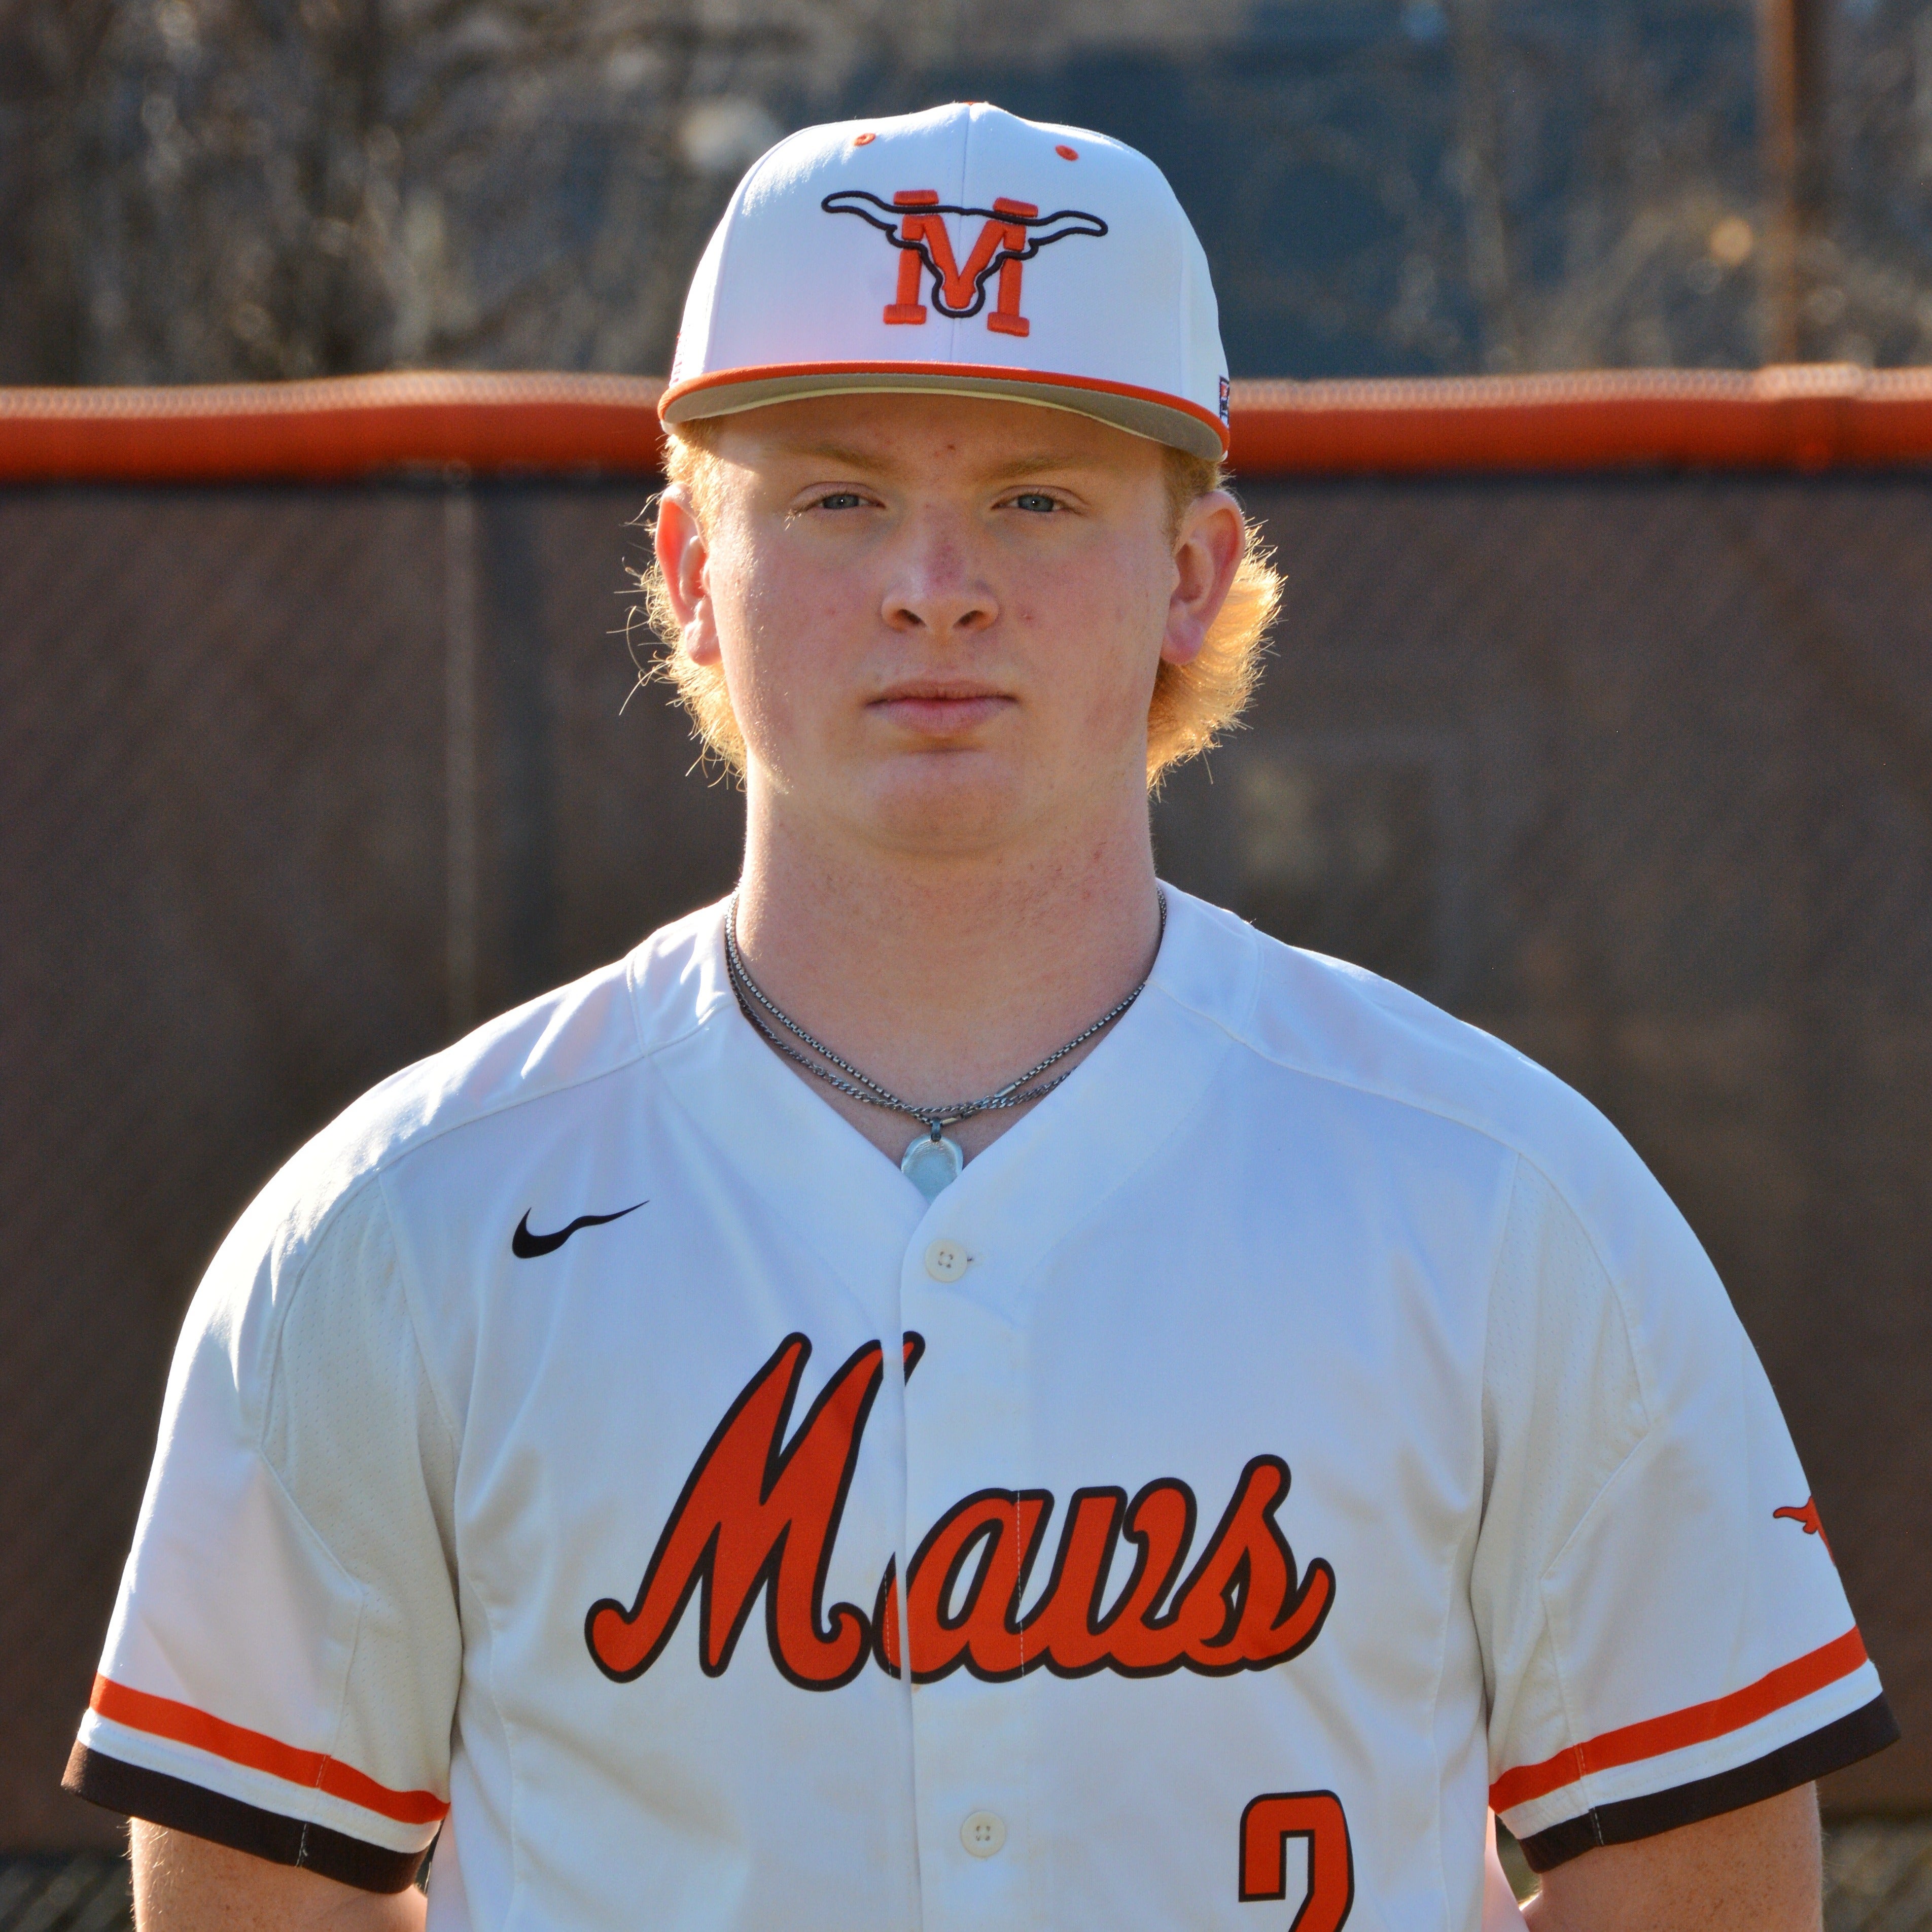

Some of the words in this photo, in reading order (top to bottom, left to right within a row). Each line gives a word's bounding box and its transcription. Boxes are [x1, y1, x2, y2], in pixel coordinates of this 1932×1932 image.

[883, 190, 1039, 337] M
[584, 1331, 1336, 1692] Mavs
[1238, 1789, 1355, 1932] 2
